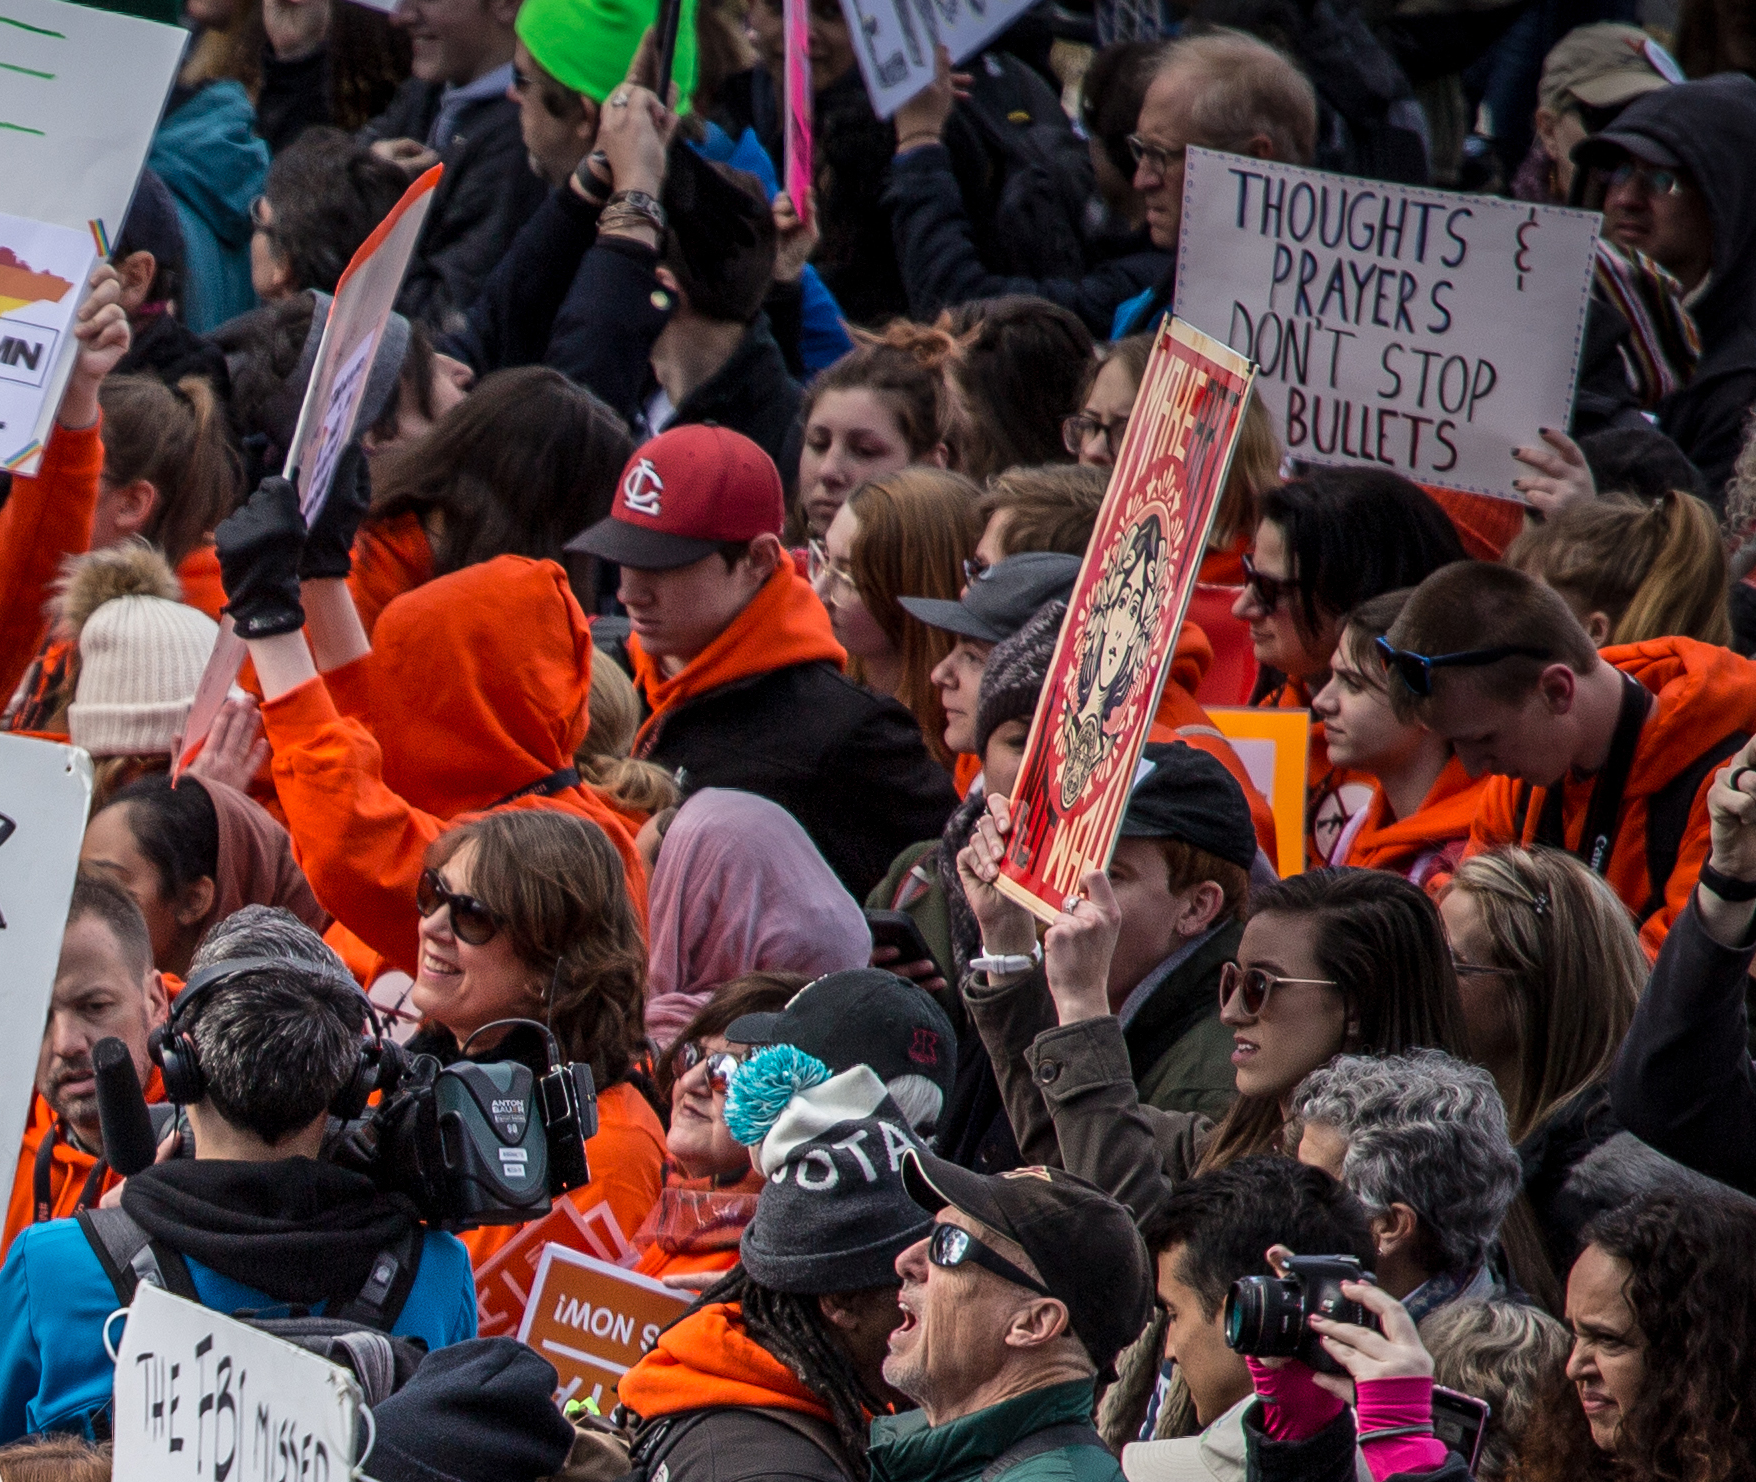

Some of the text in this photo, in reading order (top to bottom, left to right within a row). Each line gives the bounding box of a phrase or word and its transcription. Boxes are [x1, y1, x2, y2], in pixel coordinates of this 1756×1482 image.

[1228, 168, 1473, 268] THOUGHTS
[1269, 242, 1455, 334] PRAYERS
[1228, 301, 1497, 422] DON'T STOP
[1288, 386, 1457, 472] BULLETS
[136, 1352, 185, 1454] THE
